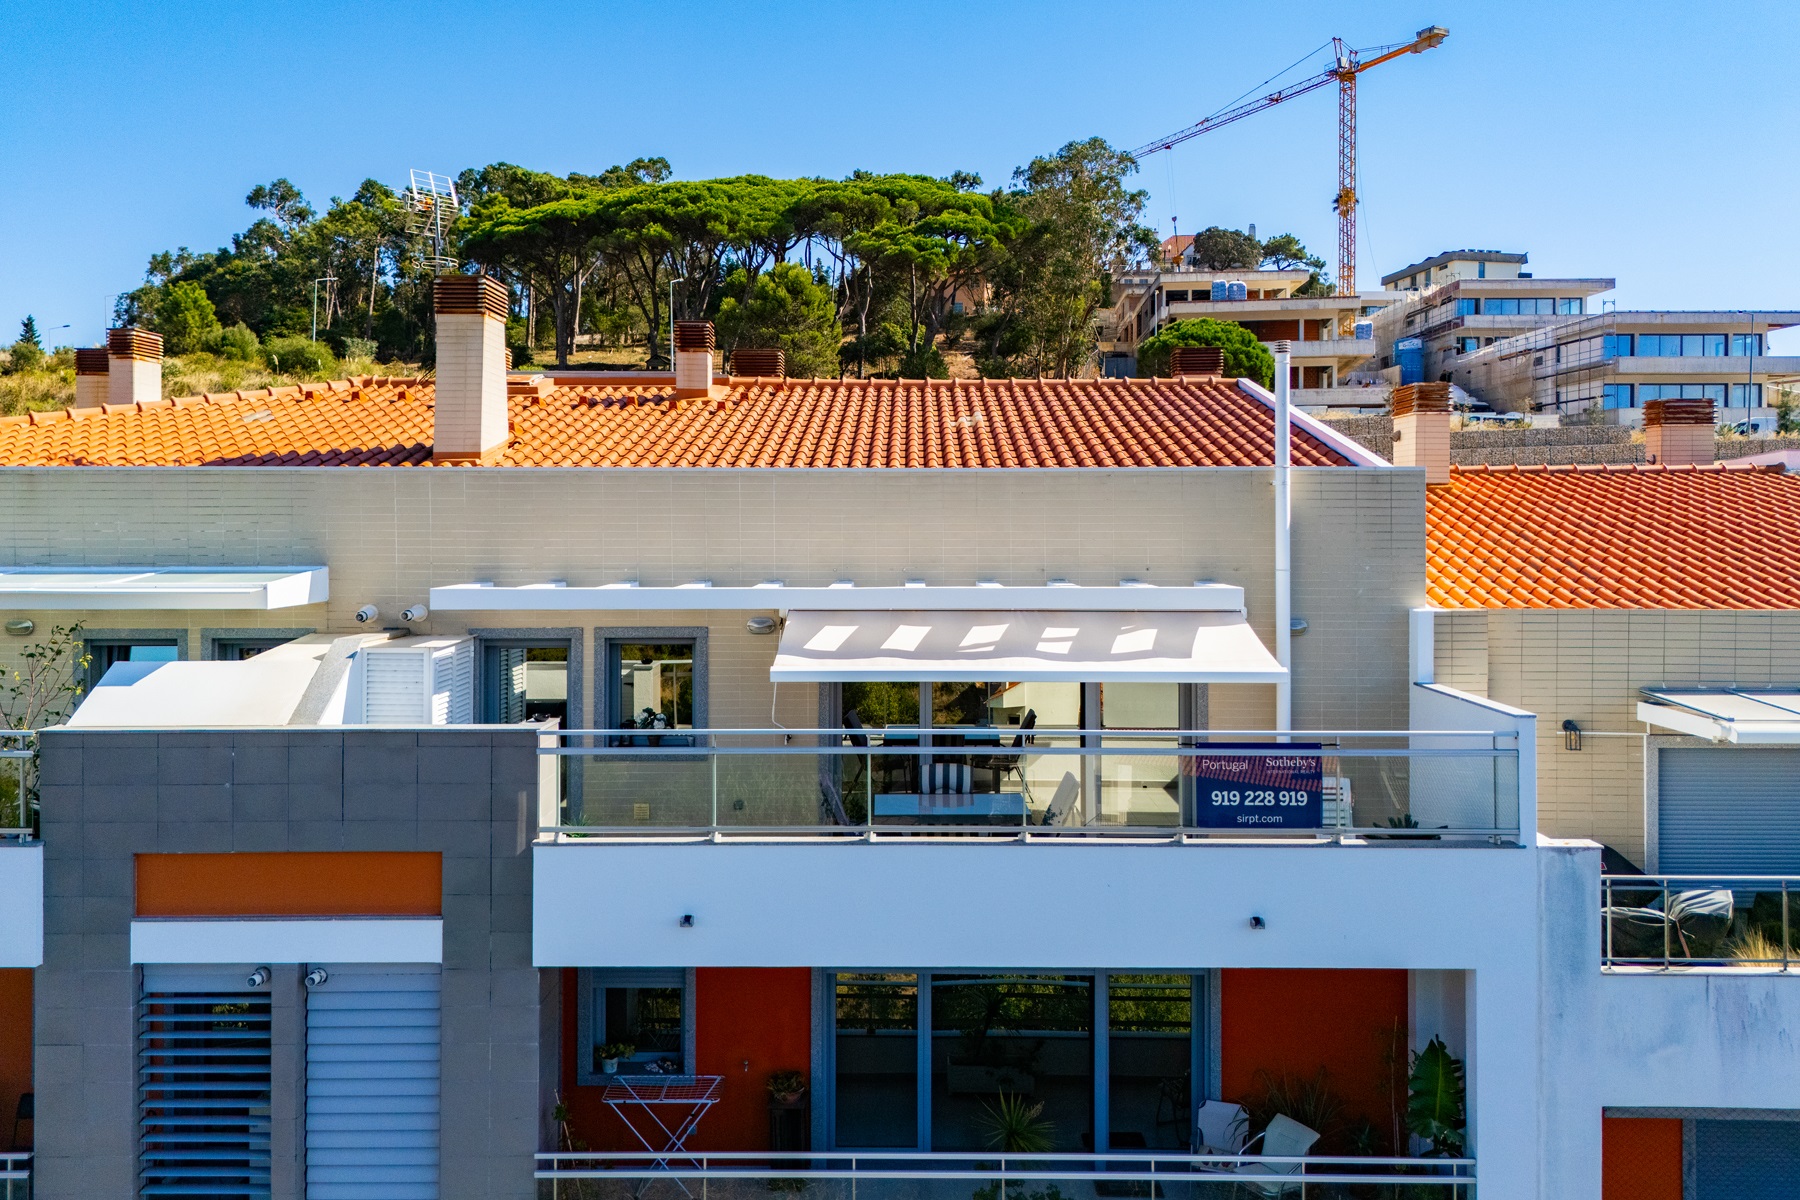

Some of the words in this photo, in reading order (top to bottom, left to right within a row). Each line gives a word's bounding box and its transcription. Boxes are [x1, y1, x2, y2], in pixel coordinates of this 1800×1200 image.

[1202, 760, 1248, 772] Portugal
[1266, 757, 1316, 769] Sotheby's
[1211, 791, 1240, 806] 919
[1244, 791, 1275, 806] 228
[1279, 791, 1308, 806] 919
[1237, 814, 1283, 824] sirpt.com
